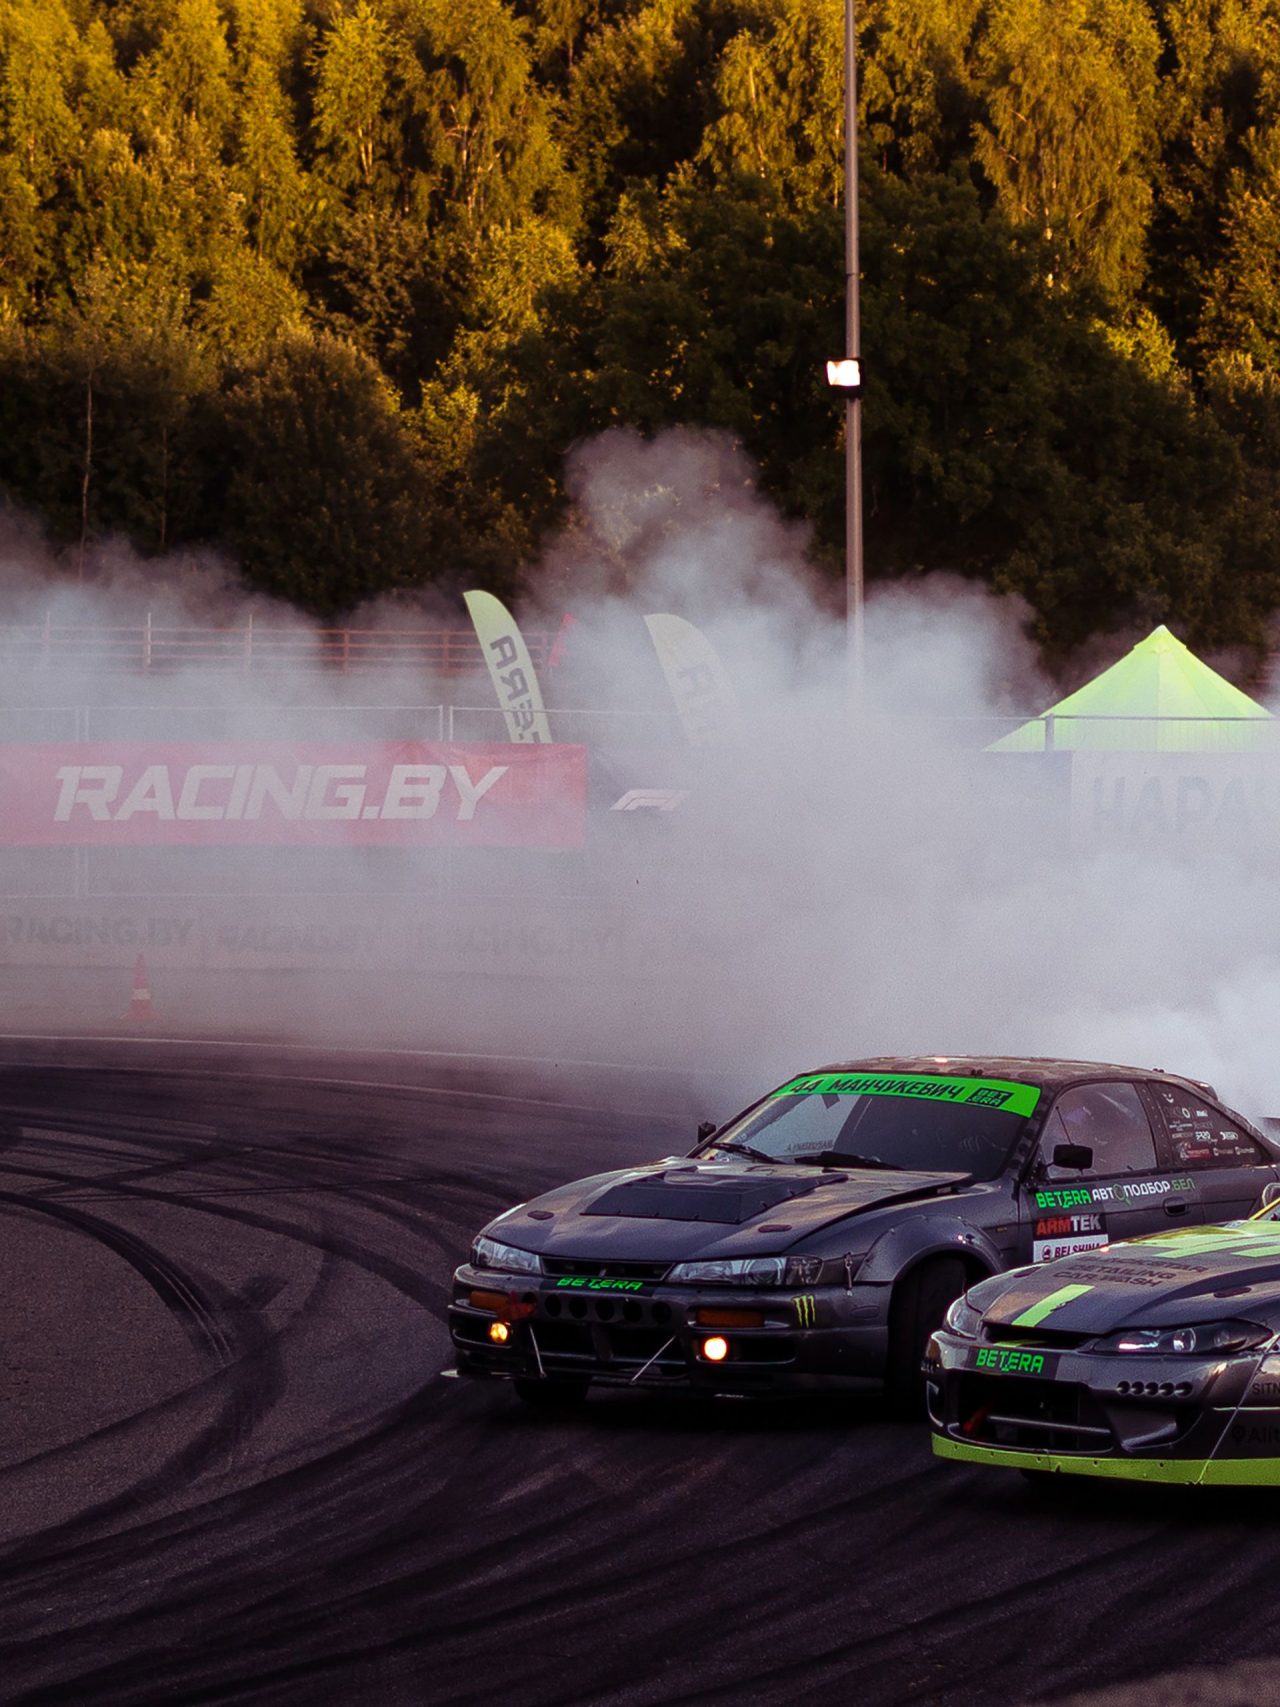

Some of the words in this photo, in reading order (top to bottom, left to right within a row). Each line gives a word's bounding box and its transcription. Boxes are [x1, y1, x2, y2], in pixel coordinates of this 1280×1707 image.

[53, 765, 508, 821] RACING.BY
[827, 1078, 967, 1099] МАНЧУКЕВИЧ
[1035, 1188, 1092, 1209] BETERA
[1036, 1214, 1101, 1236] ARMTEK
[556, 1276, 644, 1292] BETERA
[975, 1348, 1045, 1374] BETERA
